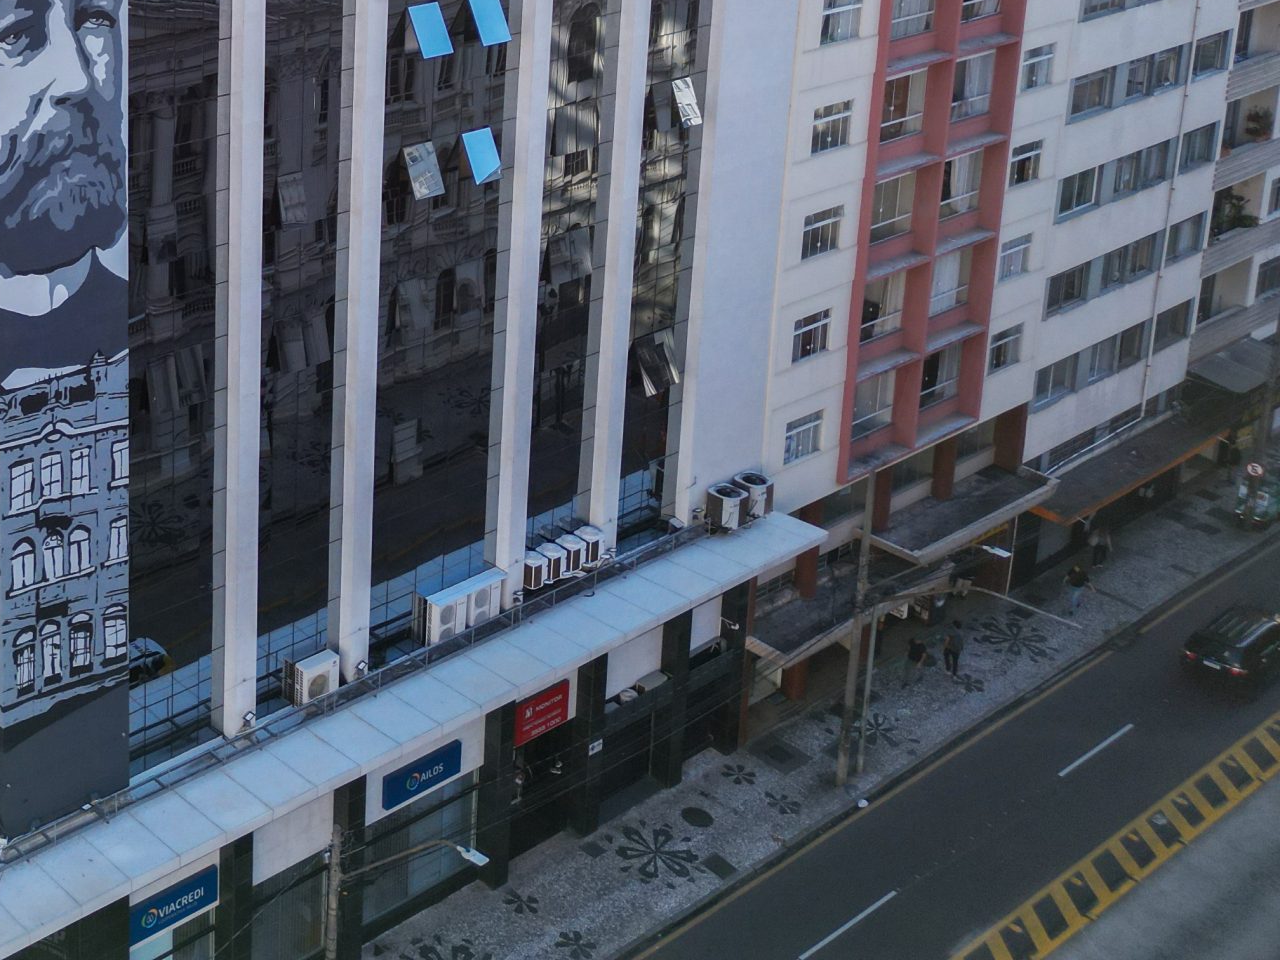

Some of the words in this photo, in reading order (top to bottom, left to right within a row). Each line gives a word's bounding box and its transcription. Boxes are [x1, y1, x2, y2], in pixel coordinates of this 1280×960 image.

[535, 694, 563, 711] MONITOR
[420, 762, 445, 782] AILOS
[158, 886, 204, 917] VIACREDI
